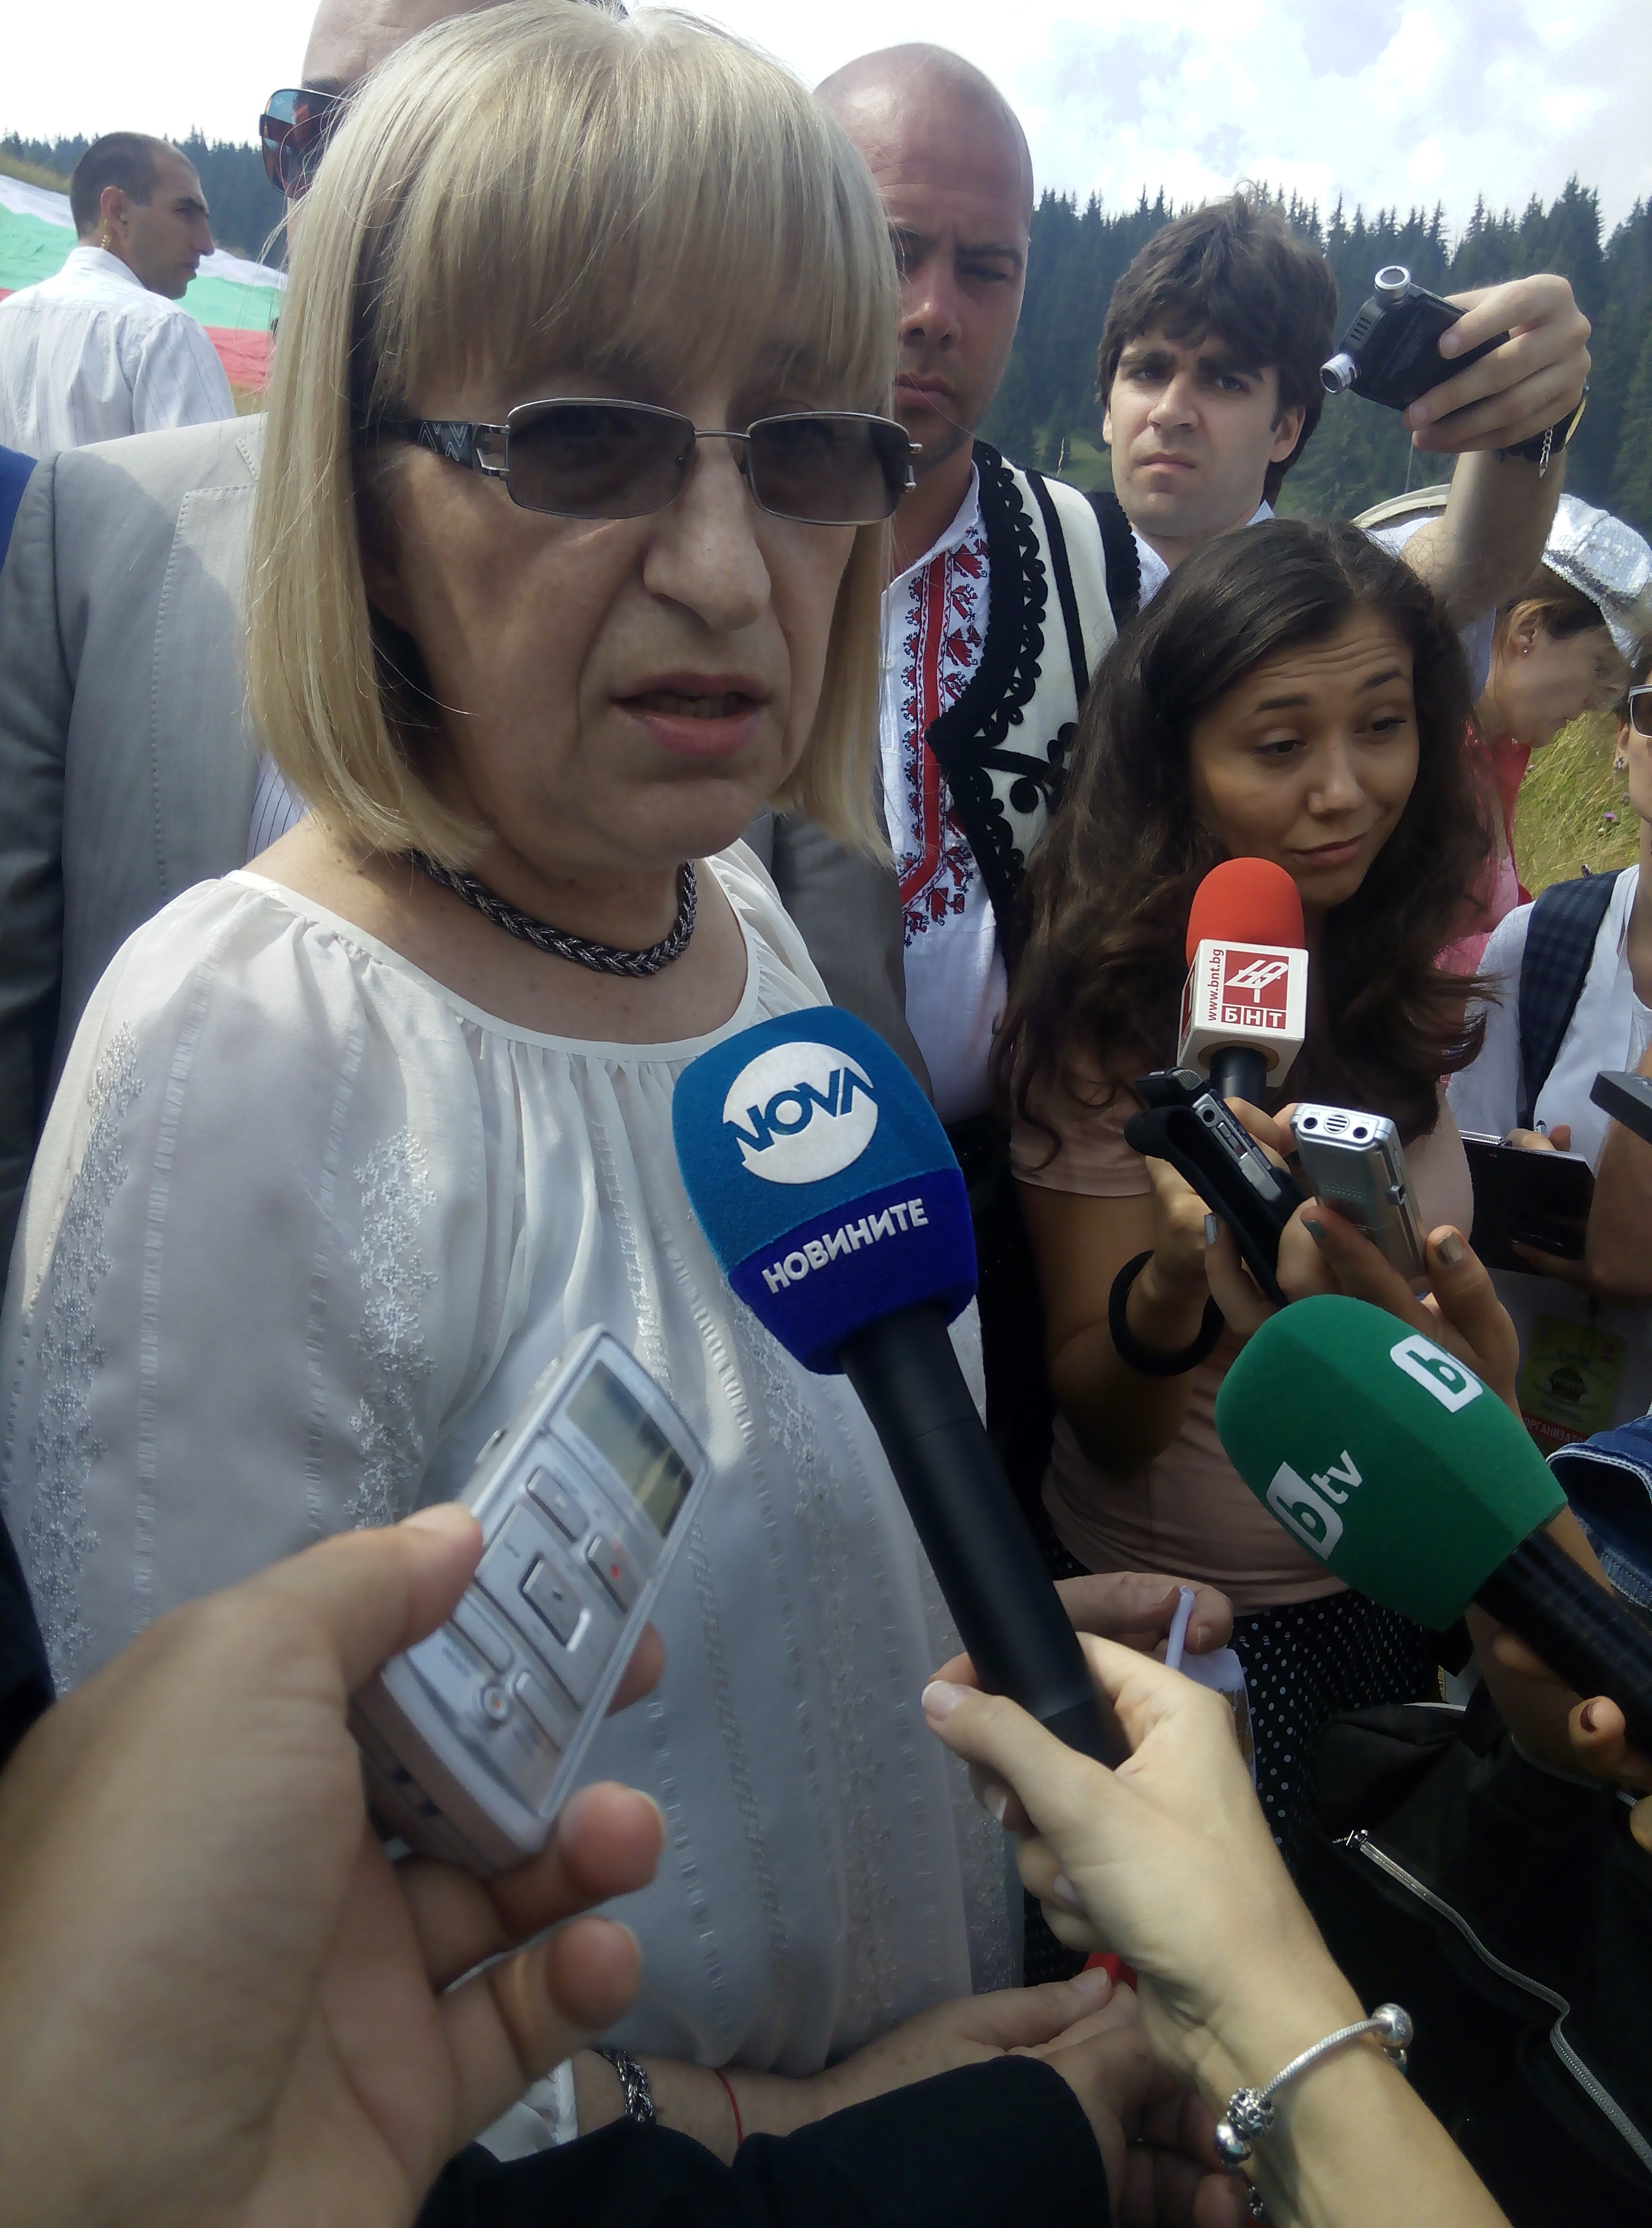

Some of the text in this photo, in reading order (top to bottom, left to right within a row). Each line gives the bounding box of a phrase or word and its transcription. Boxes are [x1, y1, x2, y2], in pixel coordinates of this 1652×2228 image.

[1207, 949, 1224, 1021] www.bnt.bg
[1225, 1008, 1282, 1028] БНТ
[723, 1067, 875, 1160] NOVA
[761, 1198, 929, 1293] НОВИНИТЕ
[1525, 1417, 1585, 1443] ОРГАНИЗАТО
